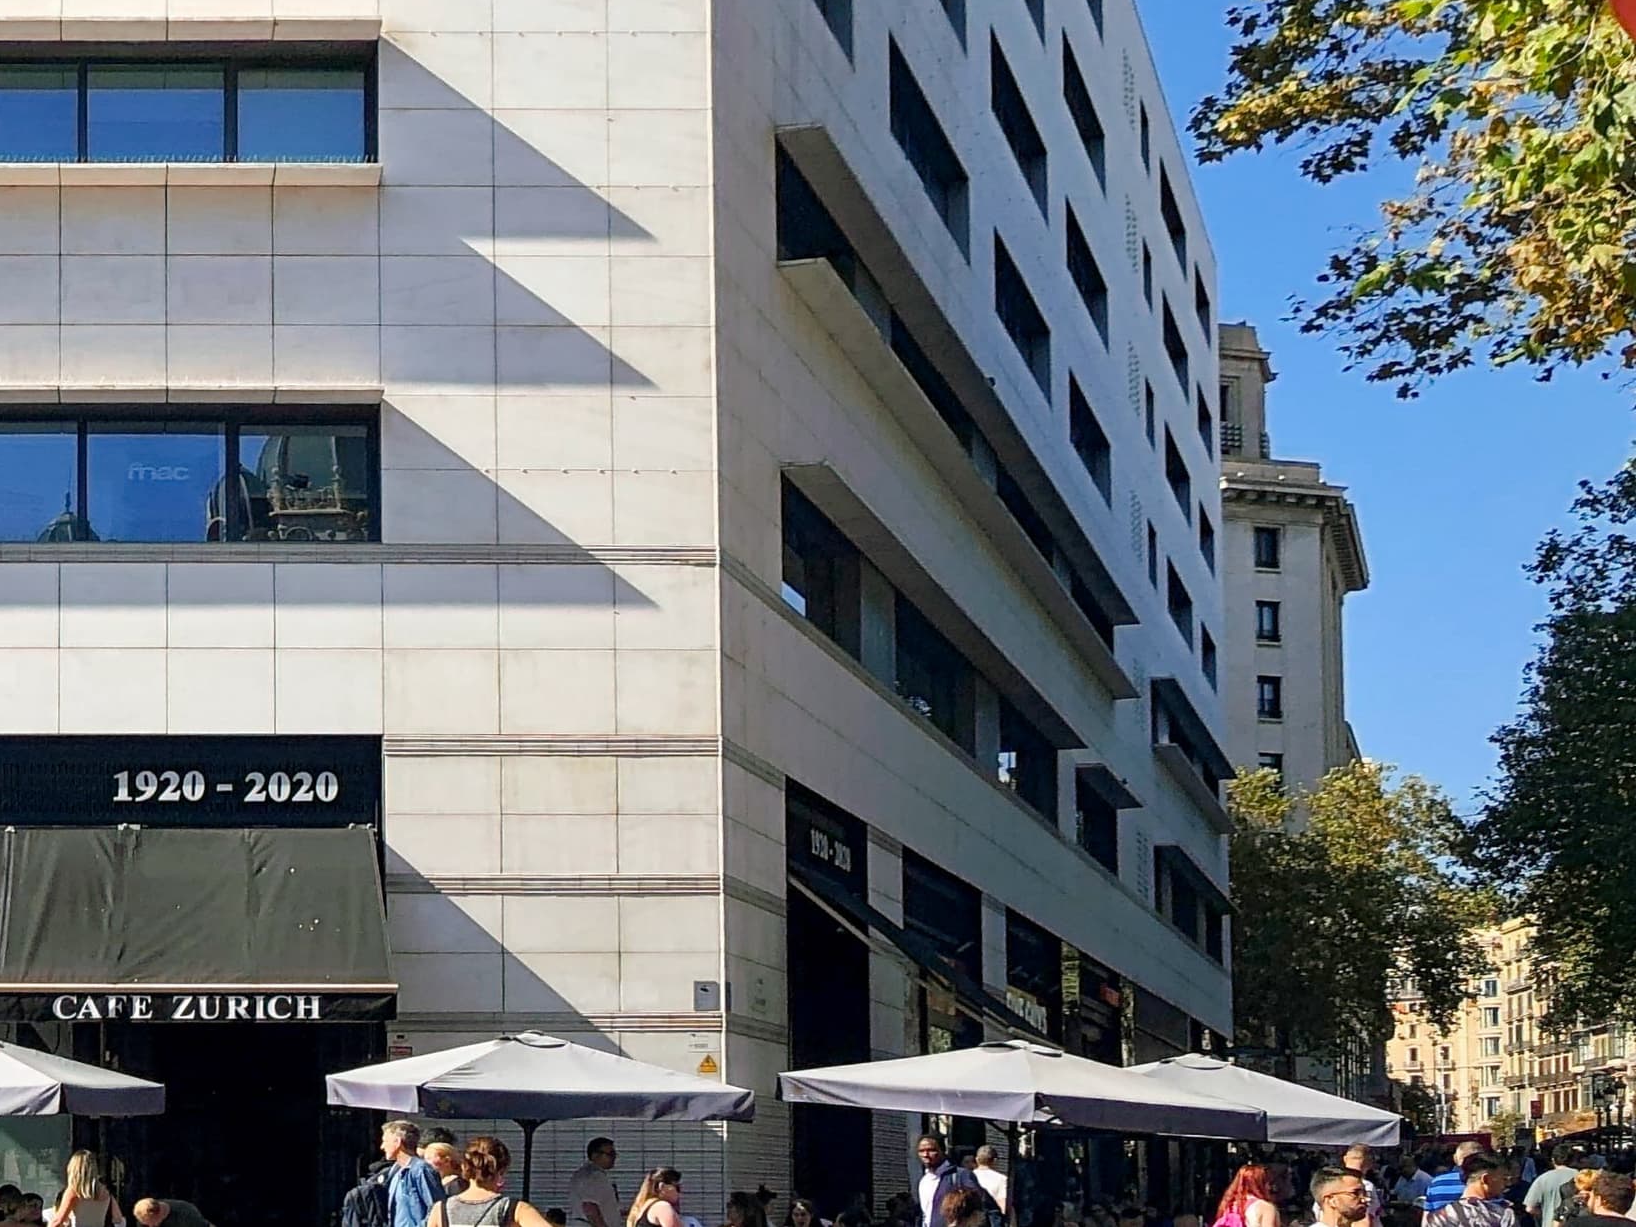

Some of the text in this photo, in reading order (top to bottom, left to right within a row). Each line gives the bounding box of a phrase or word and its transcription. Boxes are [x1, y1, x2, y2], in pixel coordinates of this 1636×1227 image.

[126, 462, 190, 481] fnac
[112, 770, 205, 802] 1920
[243, 771, 339, 802] 2020
[52, 995, 322, 1019] CAFE ZURICH
